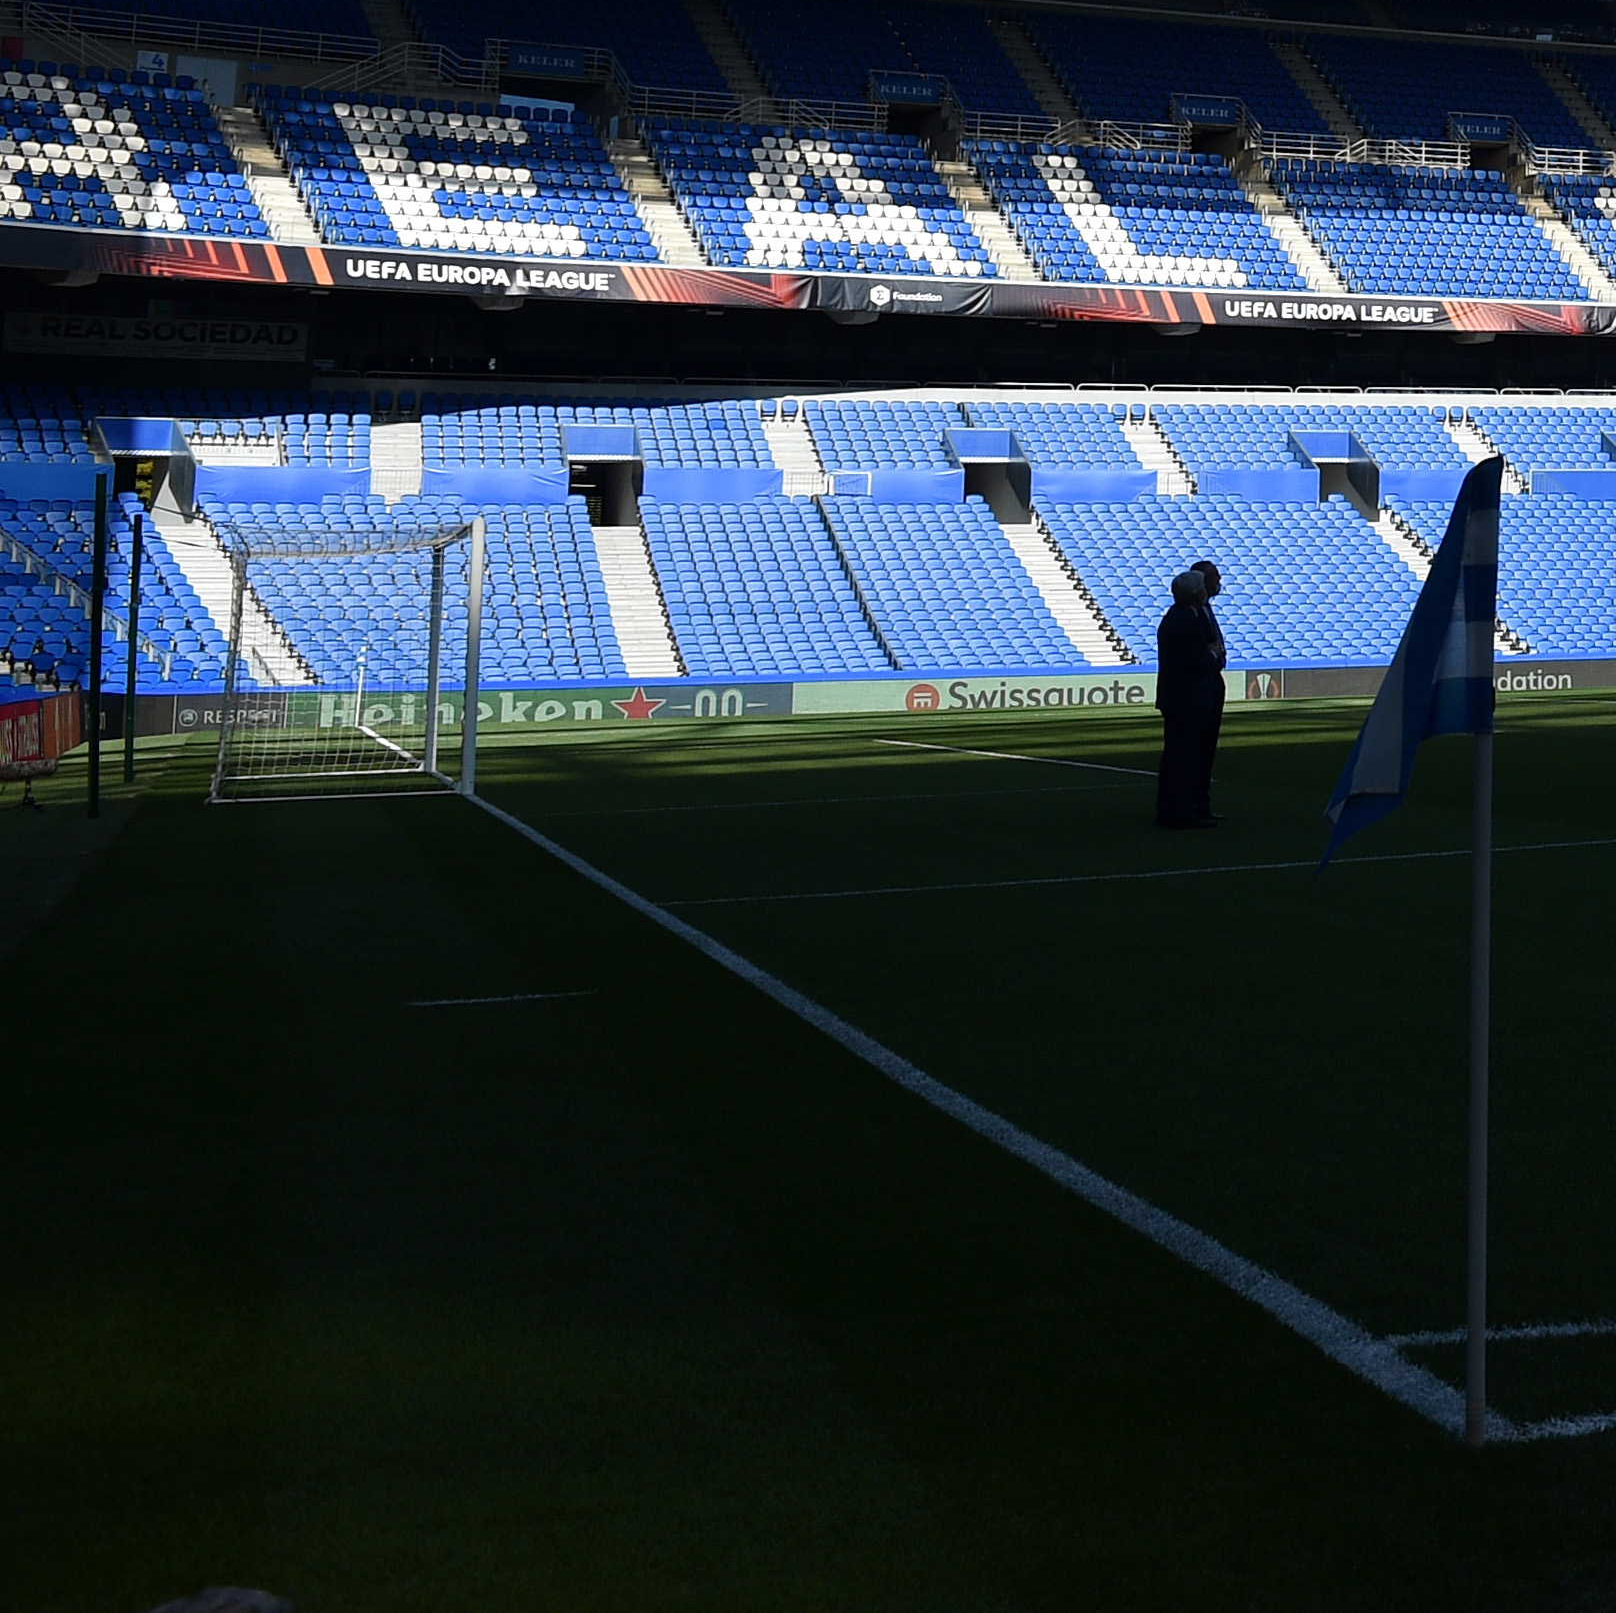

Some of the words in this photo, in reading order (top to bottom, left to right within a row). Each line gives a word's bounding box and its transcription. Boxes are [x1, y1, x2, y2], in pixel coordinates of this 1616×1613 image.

[151, 53, 165, 68] 4
[516, 54, 577, 68] KELER
[880, 84, 933, 98] KELER
[1181, 106, 1230, 118] KELER
[1457, 124, 1502, 136] KELER
[347, 259, 412, 281] UEFA
[417, 263, 511, 287] EUROPA
[516, 268, 611, 291] LEAGUE
[1225, 300, 1278, 319] UEFA
[1281, 302, 1357, 322] EUROPA
[1360, 305, 1435, 324] LEAGUE
[40, 316, 125, 340] REAL
[131, 320, 298, 345] SOCIEDAD
[1493, 670, 1573, 692] dation
[949, 679, 1145, 710] Swissquote
